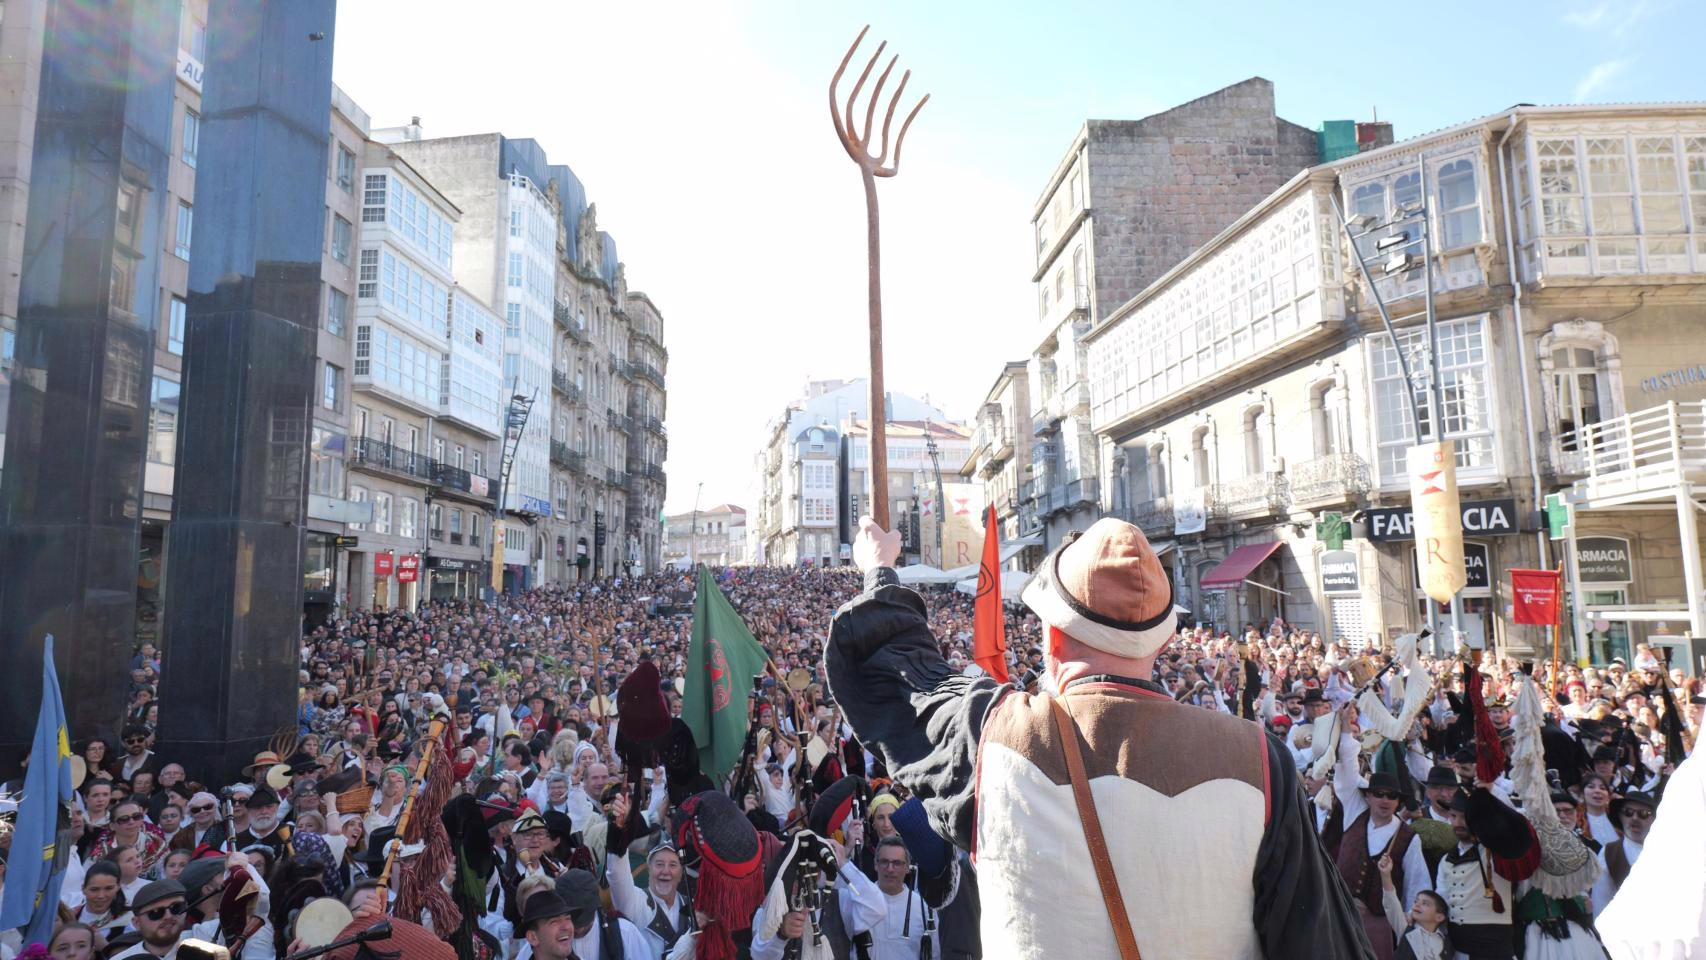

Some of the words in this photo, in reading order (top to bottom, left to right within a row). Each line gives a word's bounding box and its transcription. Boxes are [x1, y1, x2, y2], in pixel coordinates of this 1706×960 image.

[1372, 507, 1510, 536] FARCIA
[956, 541, 971, 564] R
[1426, 537, 1453, 565] R
[1577, 550, 1626, 561] ARMACIA
[1322, 562, 1357, 575] FARMACIA
